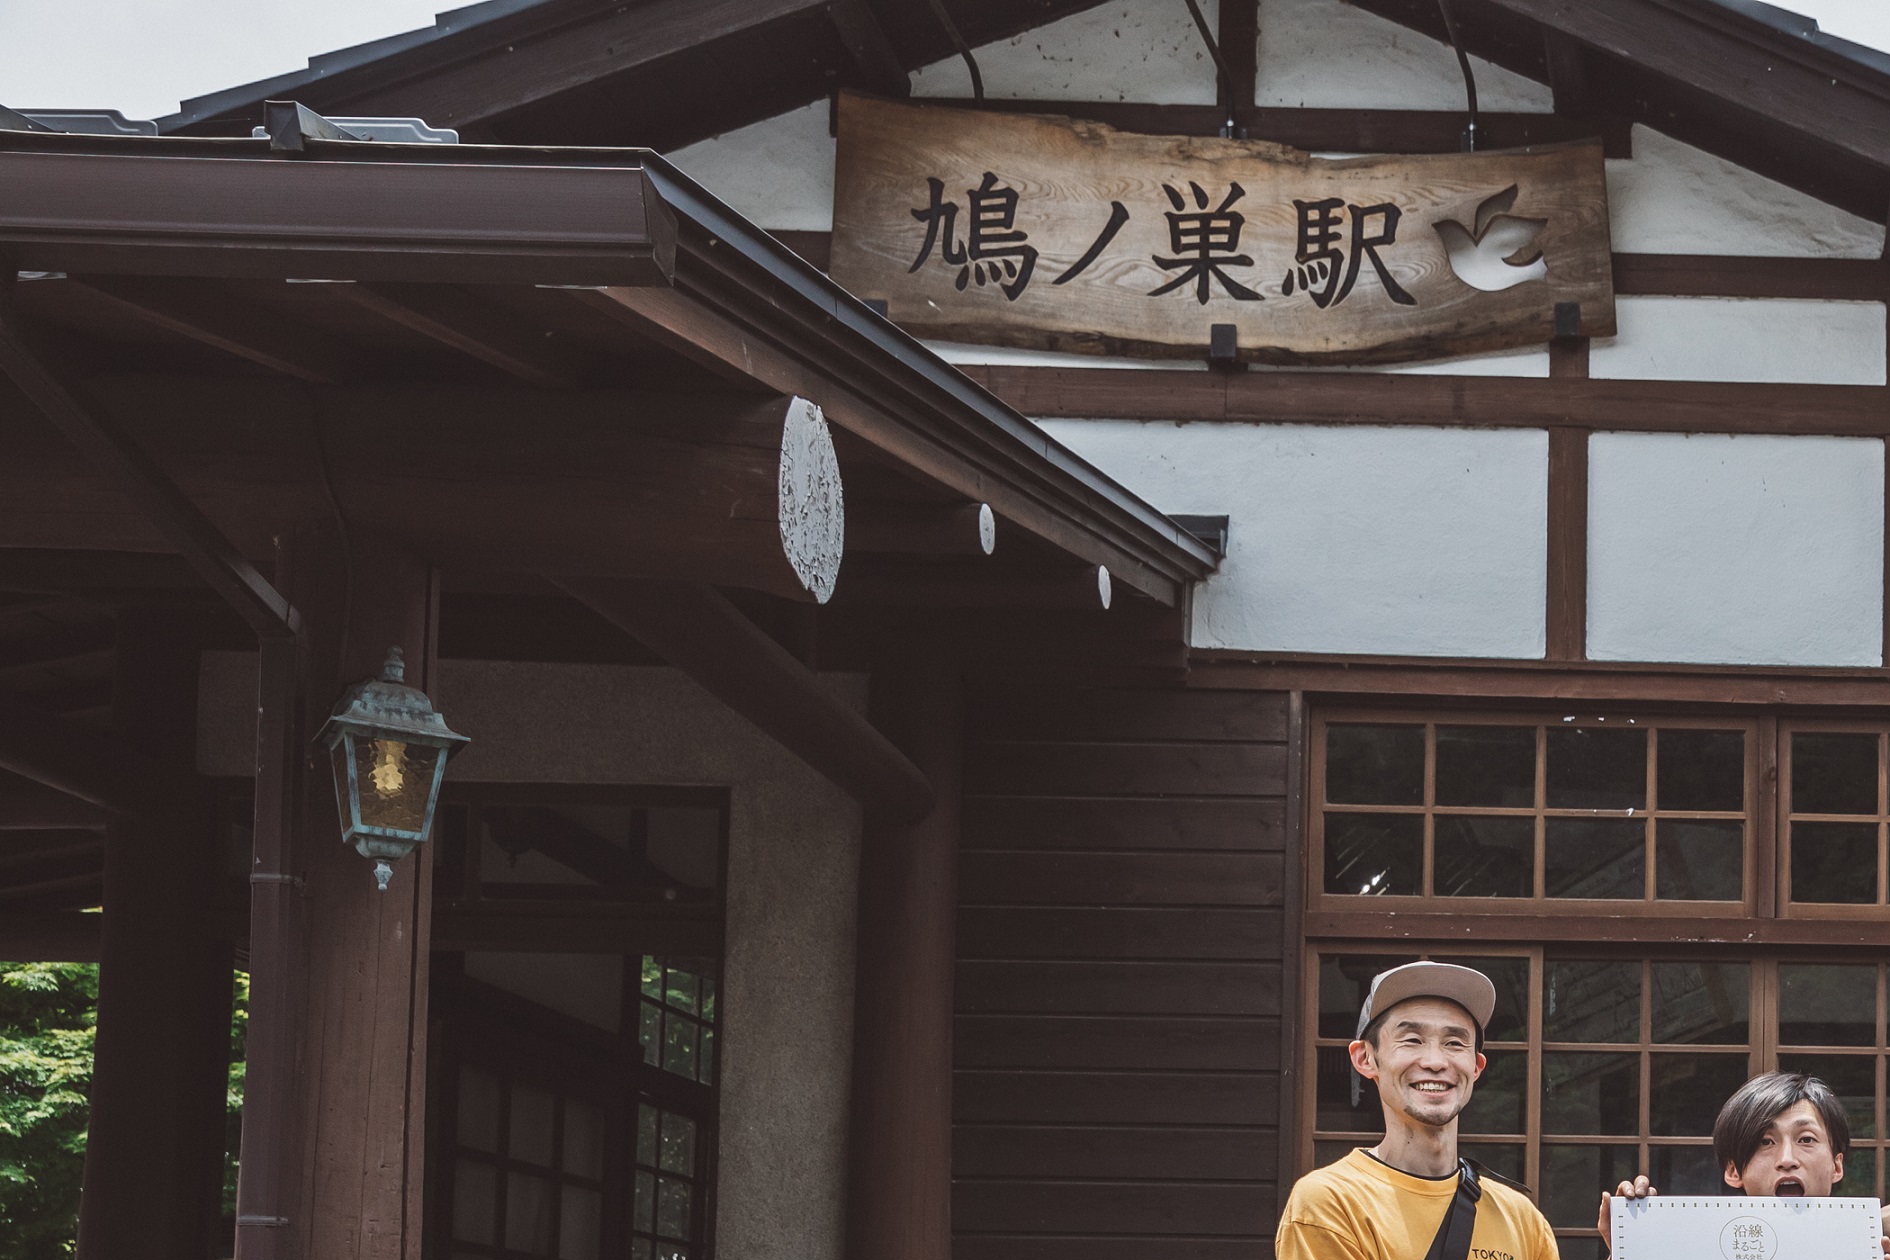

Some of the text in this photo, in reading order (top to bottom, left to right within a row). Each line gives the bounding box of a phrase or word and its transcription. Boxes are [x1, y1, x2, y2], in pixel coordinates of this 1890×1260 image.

[908, 171, 1417, 308] 鳩ノ巣駅
[1733, 1224, 1764, 1238] 沿線
[1732, 1239, 1765, 1253] まるごと
[1735, 1253, 1763, 1260] 株式会社
